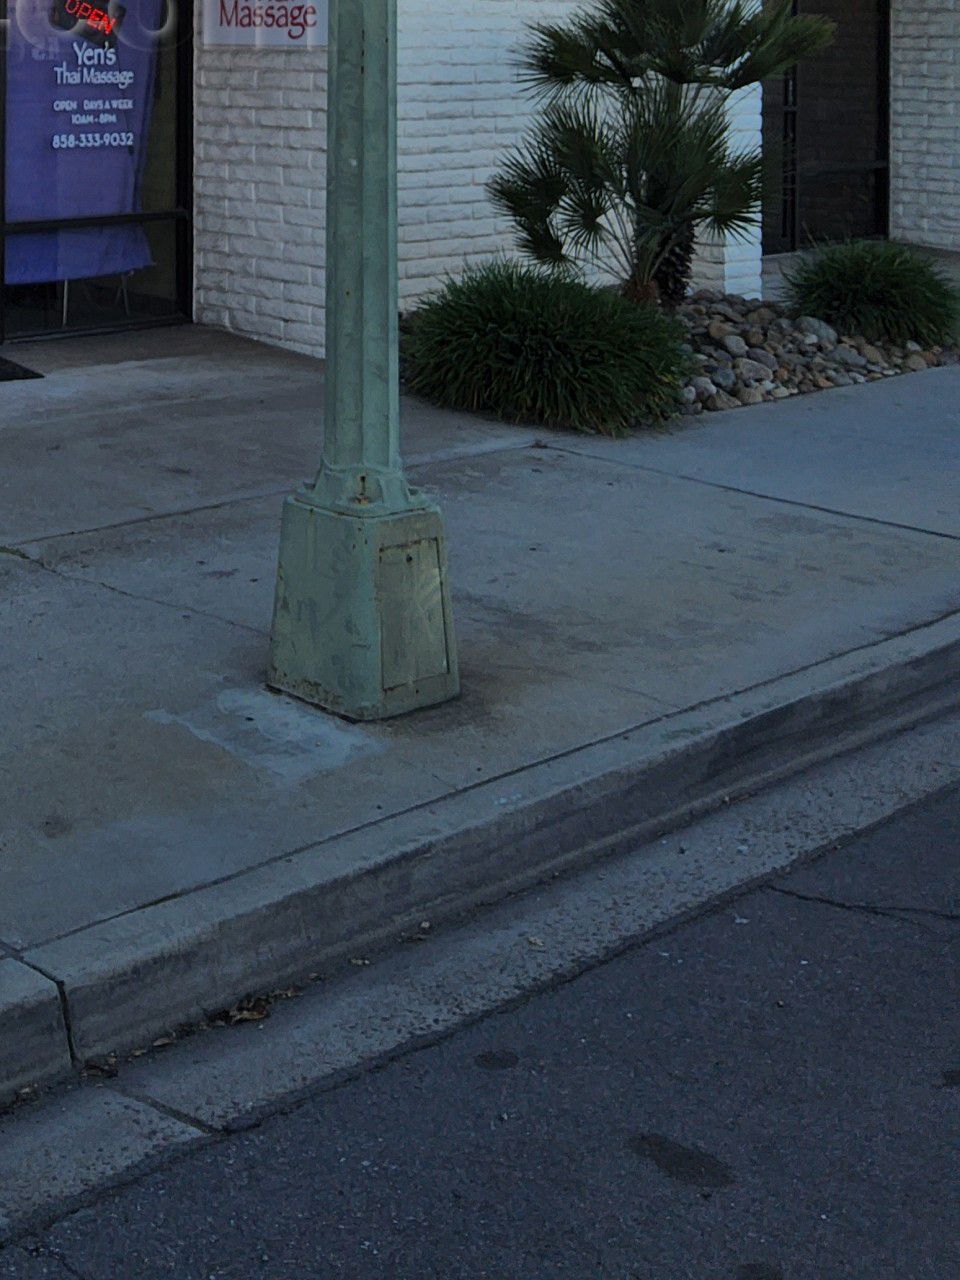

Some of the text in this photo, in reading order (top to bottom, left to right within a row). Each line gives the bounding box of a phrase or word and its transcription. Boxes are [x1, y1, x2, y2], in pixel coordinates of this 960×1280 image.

[73, 41, 116, 65] Yen's
[53, 61, 134, 89] Thai Massage
[54, 100, 77, 111] OPEN
[84, 100, 103, 110] DAYS
[111, 99, 133, 109] WEEK
[72, 114, 93, 124] 10AM
[53, 133, 133, 148] 858-333-9032
